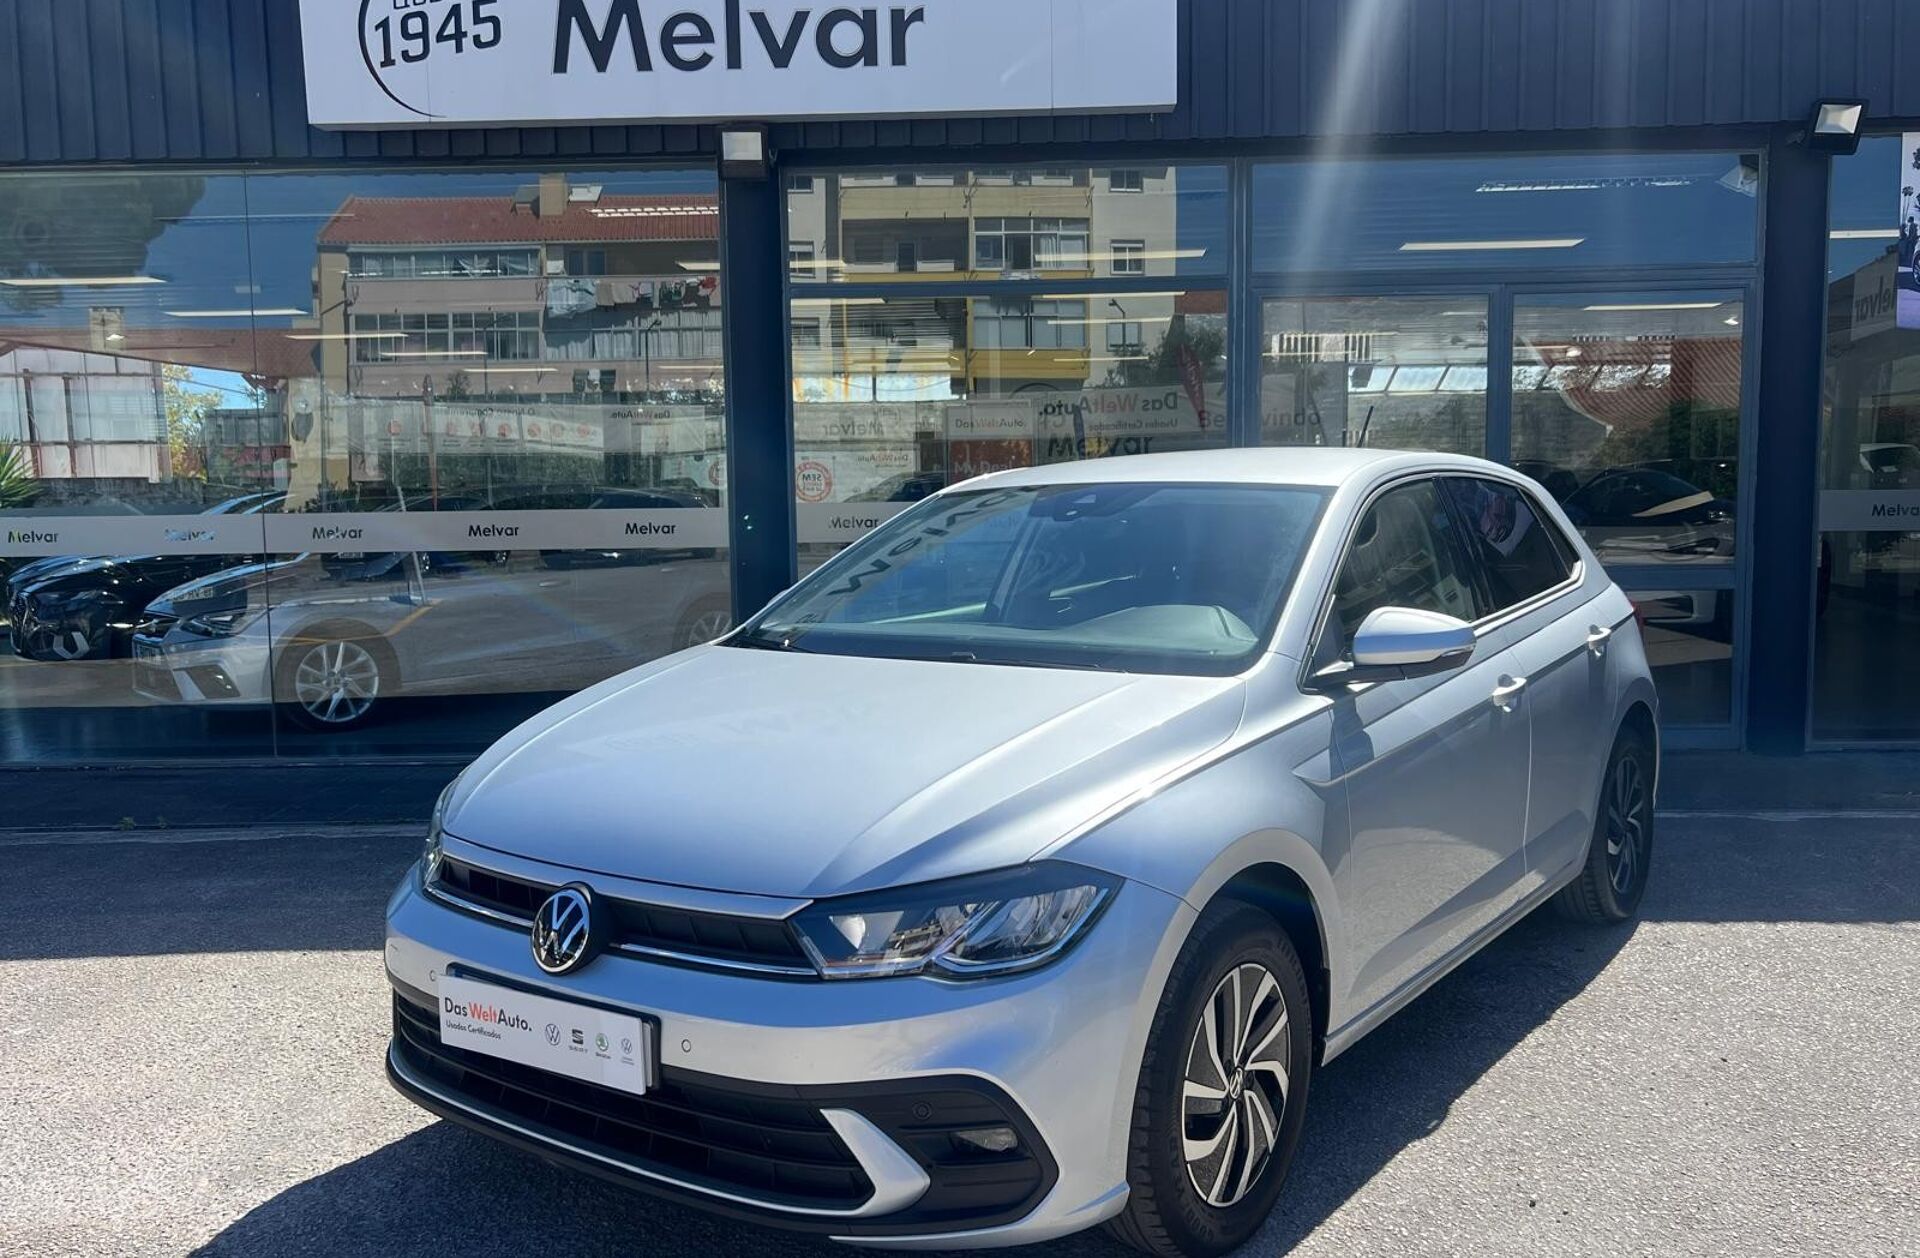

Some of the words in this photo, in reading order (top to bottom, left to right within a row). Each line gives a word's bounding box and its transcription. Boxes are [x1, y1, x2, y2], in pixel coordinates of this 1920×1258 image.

[374, 0, 501, 68] 1945
[552, 0, 924, 74] Melvar
[1872, 503, 1920, 517] Melva
[312, 526, 364, 540] Melvar
[468, 523, 520, 538] Melvar
[624, 519, 676, 535] Melvar
[8, 529, 59, 544] Melvar
